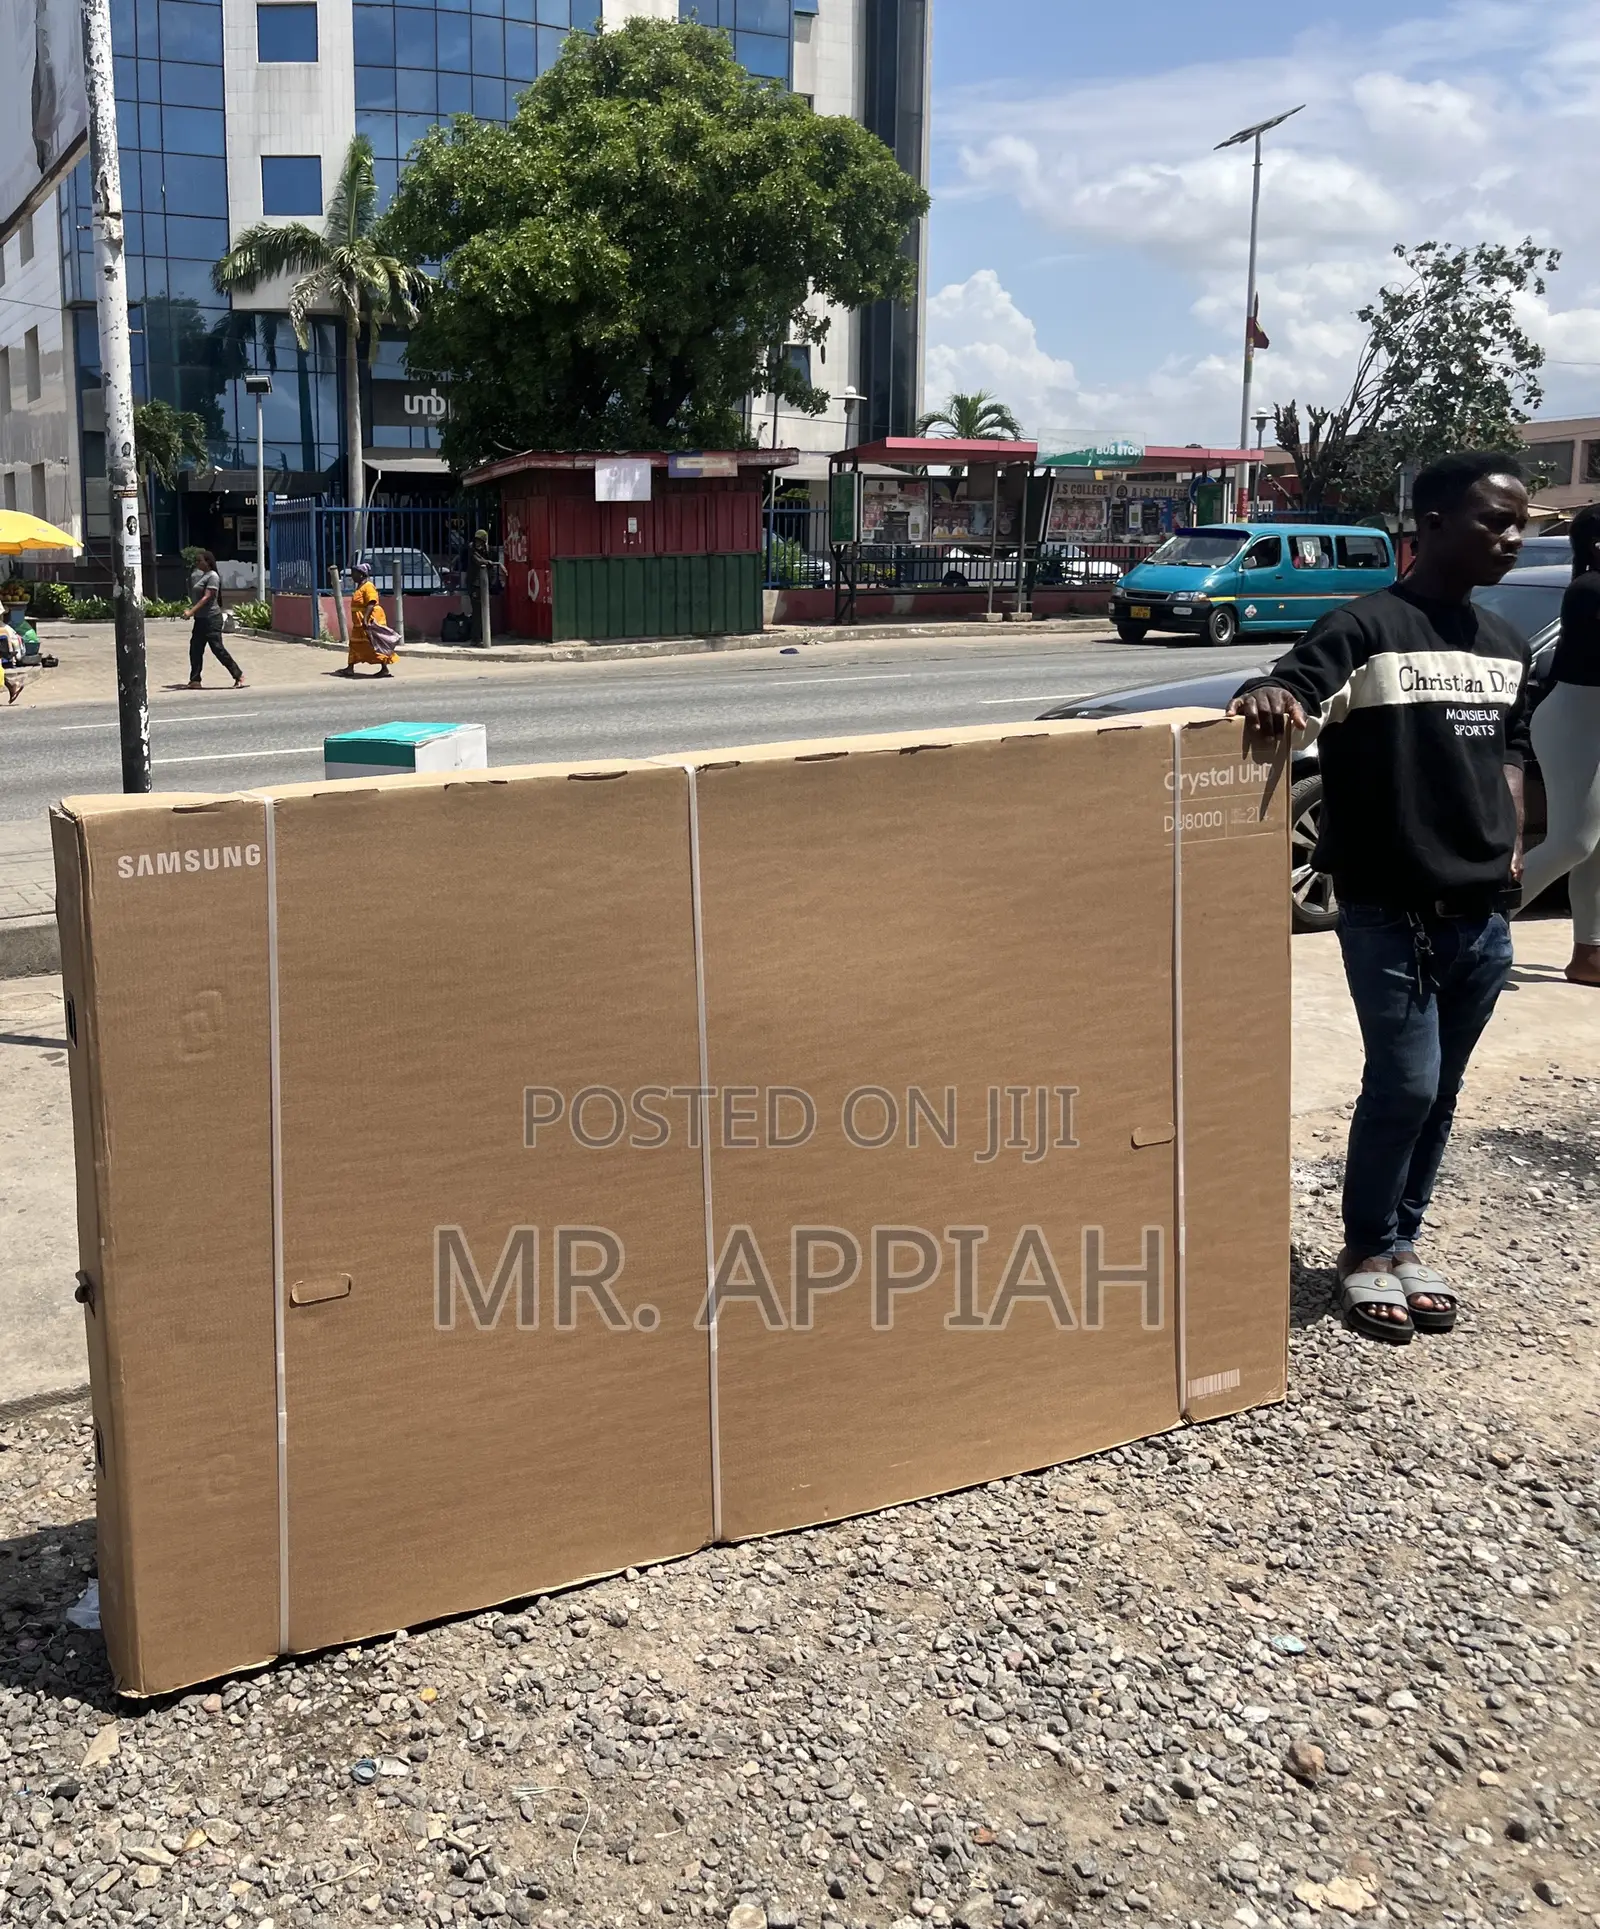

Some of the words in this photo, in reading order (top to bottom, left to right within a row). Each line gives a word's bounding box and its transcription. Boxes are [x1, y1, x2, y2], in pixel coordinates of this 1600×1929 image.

[404, 388, 446, 415] umb
[1096, 444, 1116, 455] BUS
[1070, 483, 1109, 495] COLLEGE
[1399, 665, 1485, 693] Christian
[1445, 708, 1501, 722] MONSIEUR
[1453, 724, 1496, 737] SPORTS
[1163, 765, 1234, 795] Crystal
[117, 843, 262, 879] SAMSUNG
